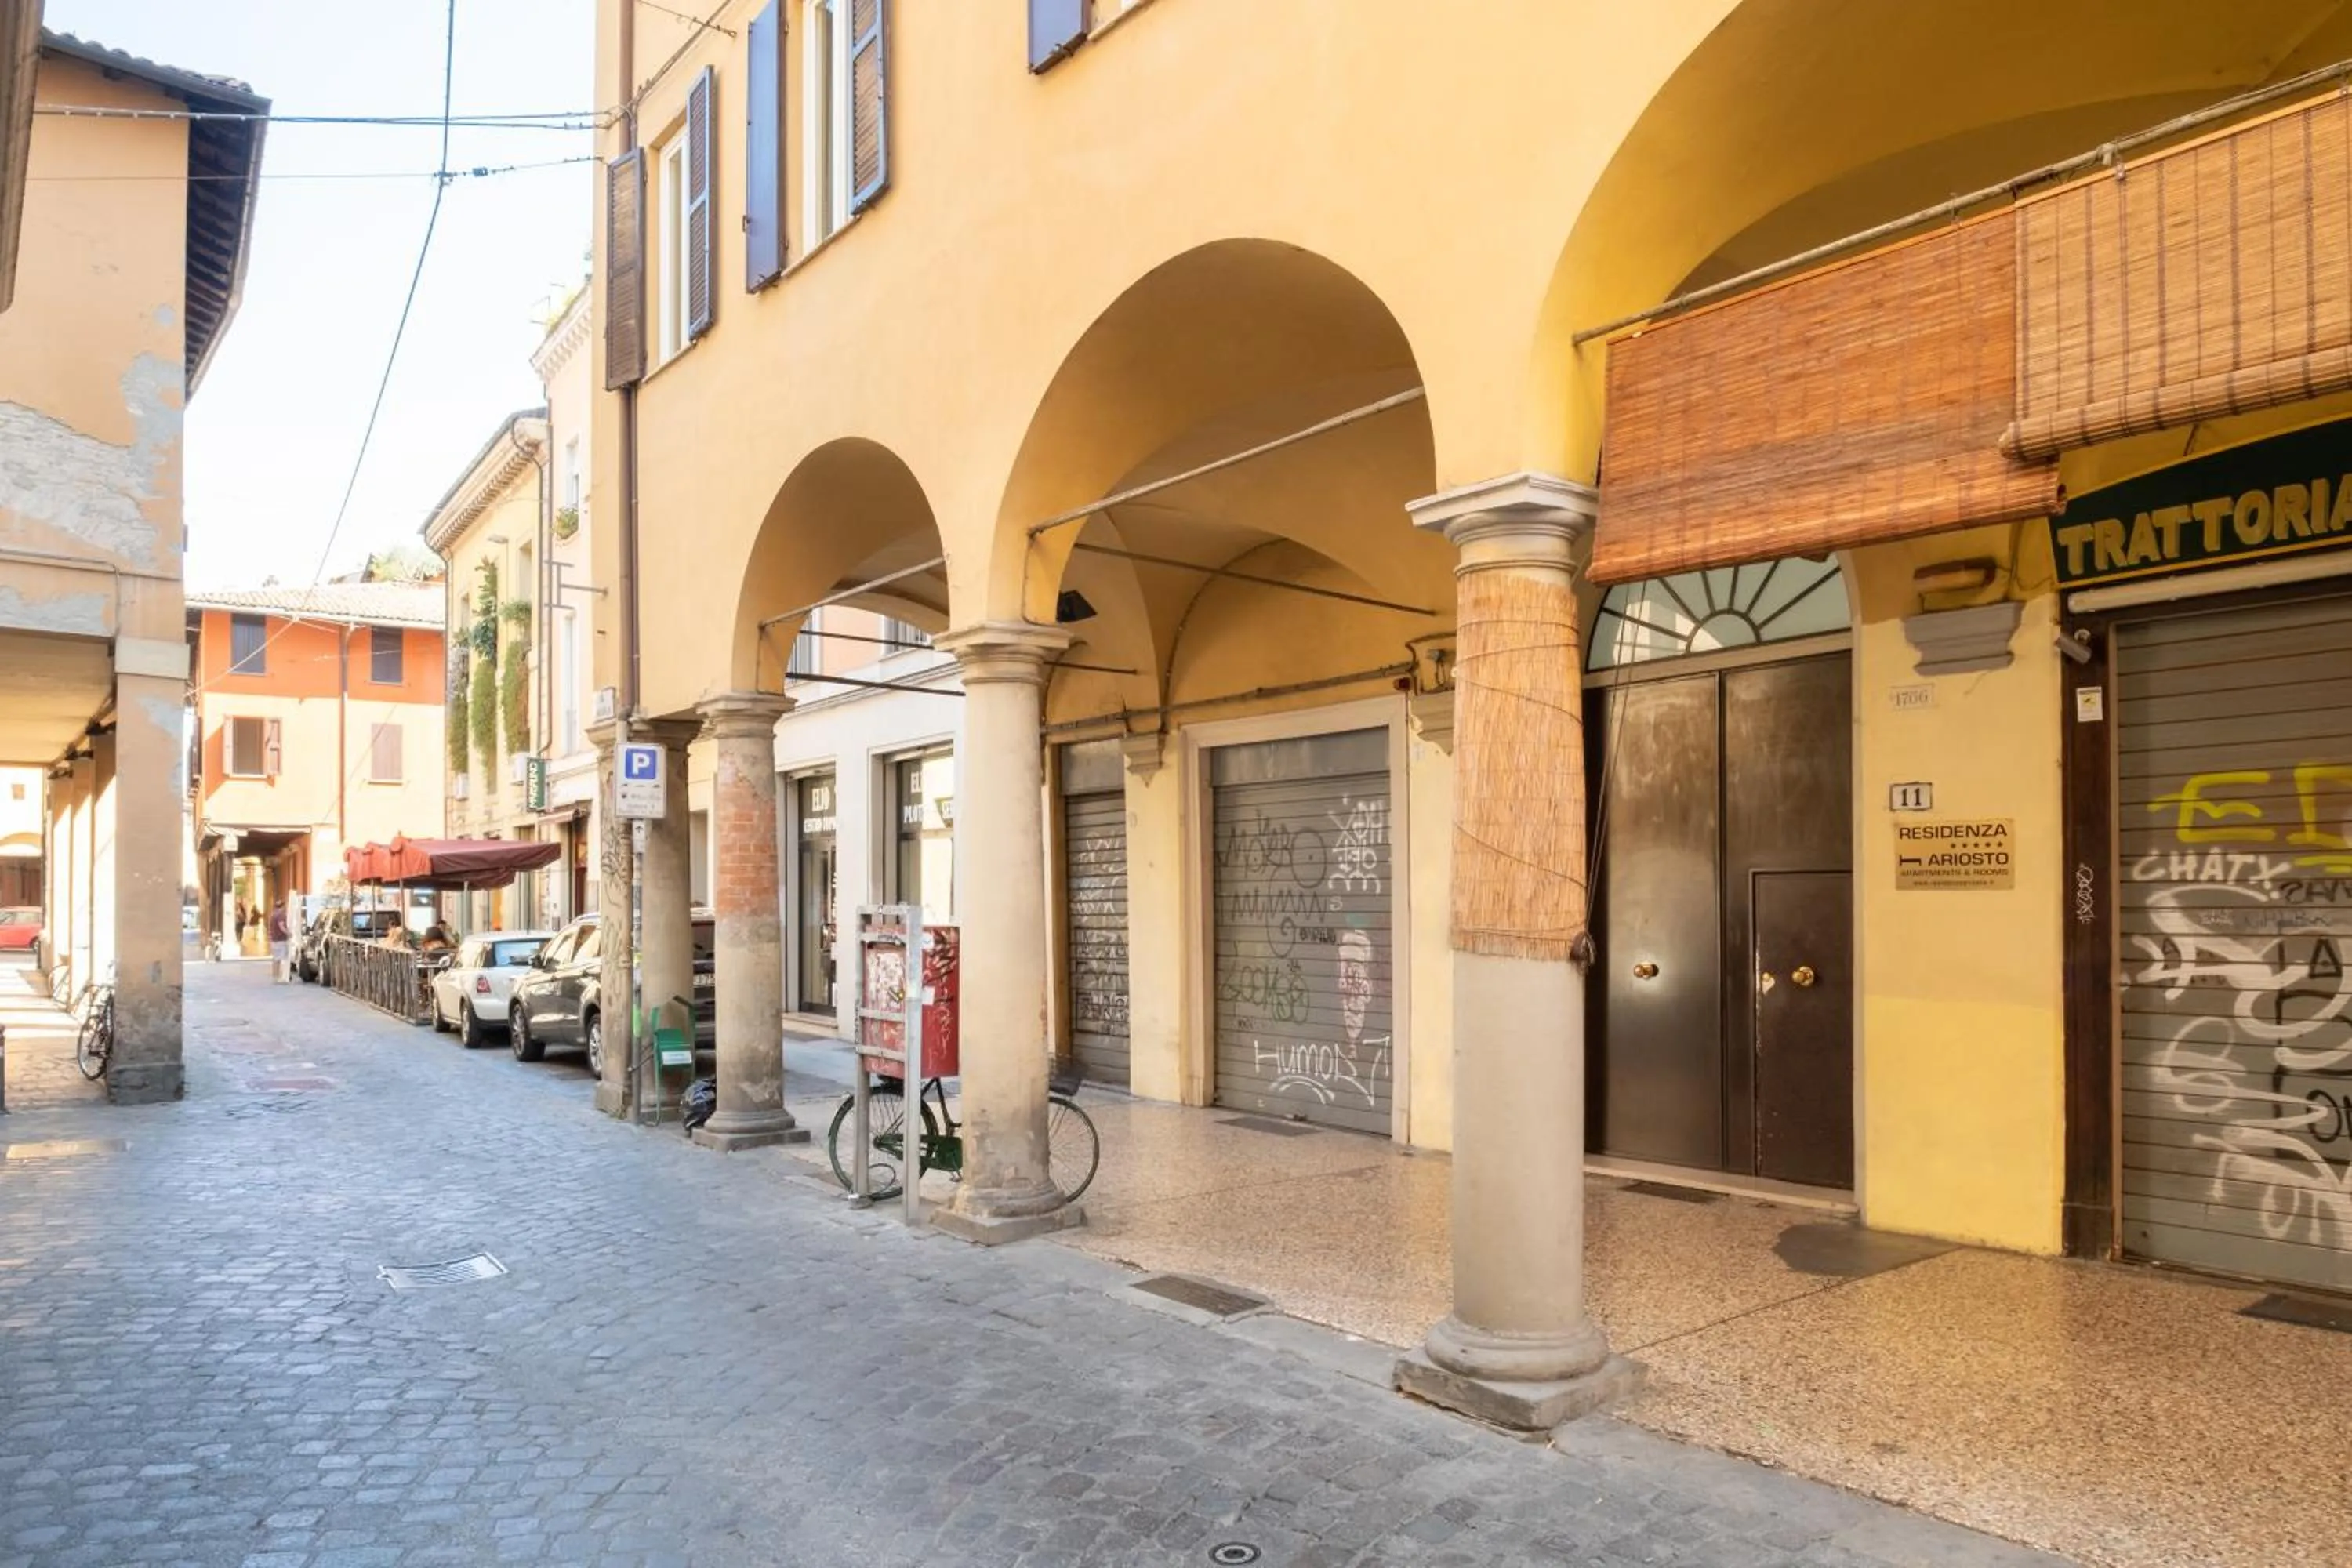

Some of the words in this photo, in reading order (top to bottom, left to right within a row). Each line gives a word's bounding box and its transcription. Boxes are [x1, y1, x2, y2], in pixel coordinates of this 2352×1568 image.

[2057, 473, 2352, 576] TRATTORIA
[631, 752, 650, 775] P
[1900, 787, 1922, 808] 11
[1899, 824, 2008, 840] RESIDENZA
[1928, 851, 2009, 867] ARIOSTO
[1973, 868, 2009, 877] ROOMS
